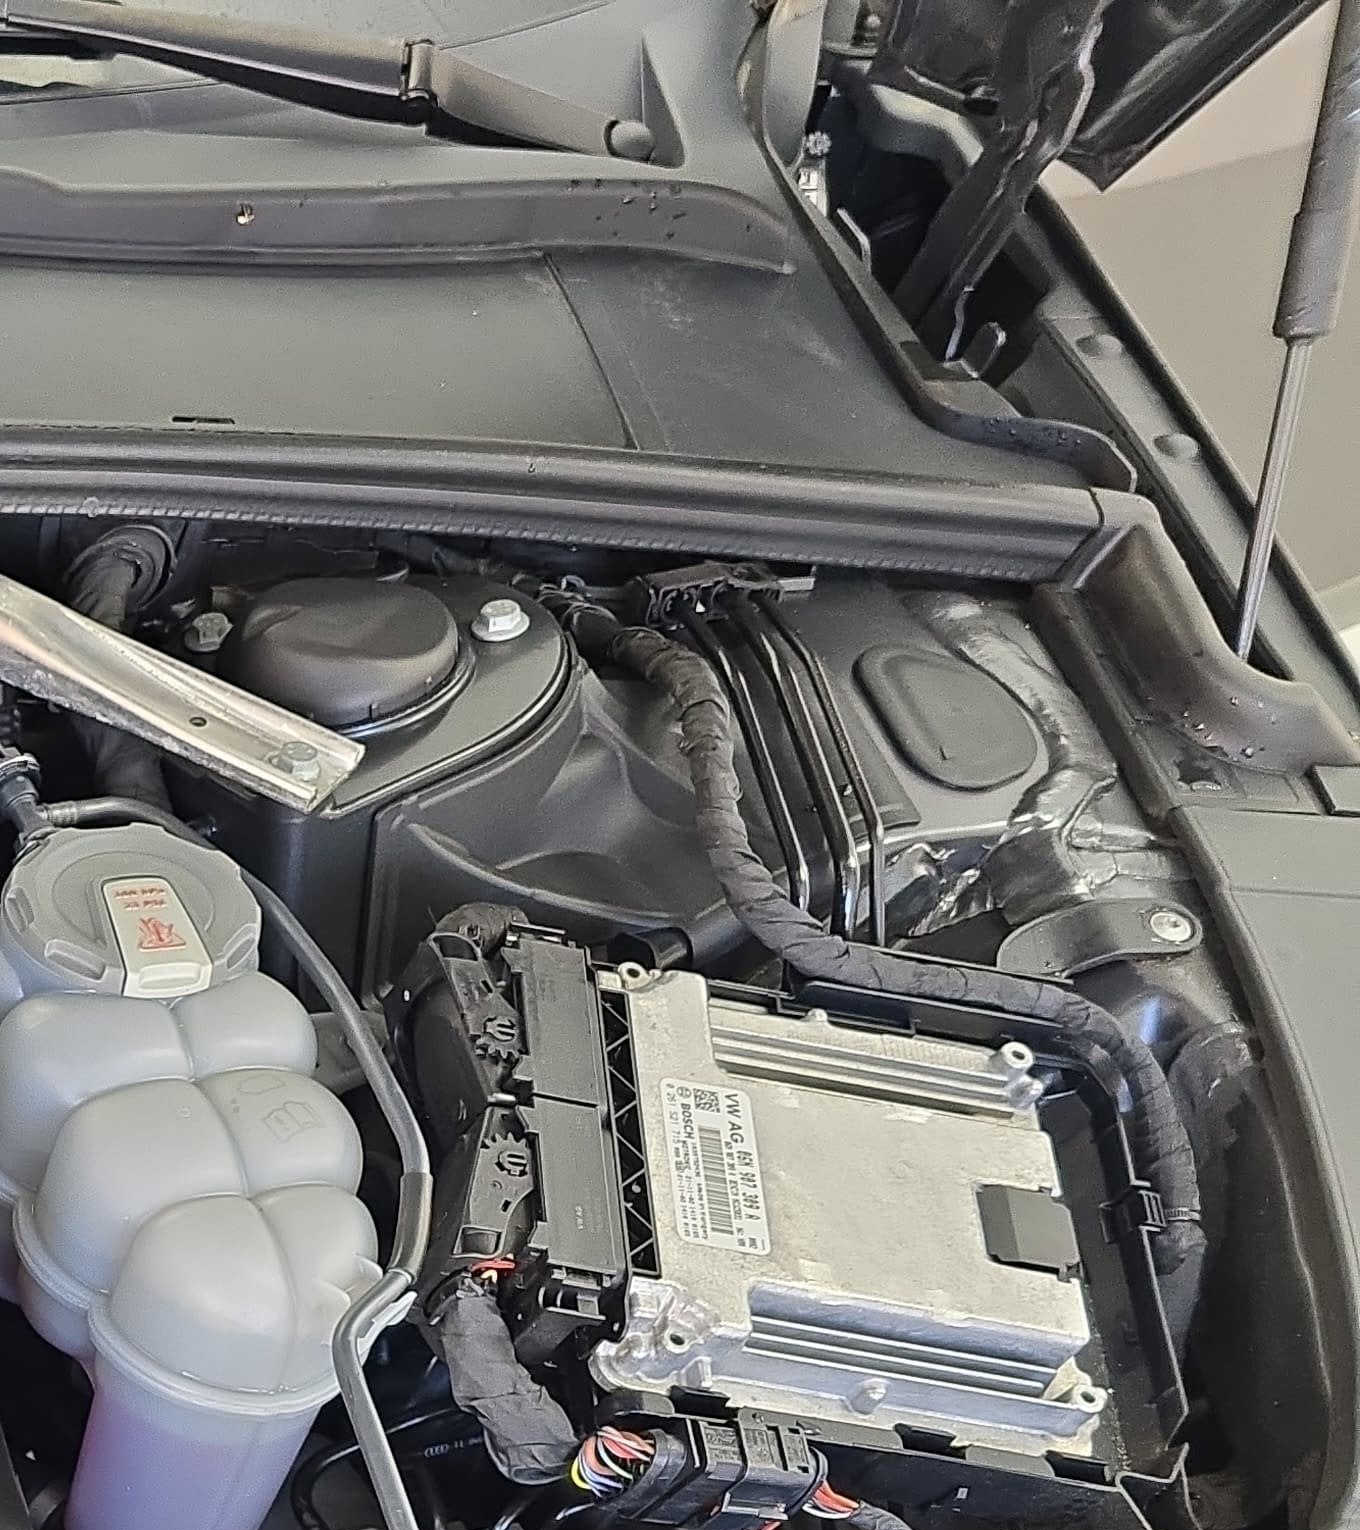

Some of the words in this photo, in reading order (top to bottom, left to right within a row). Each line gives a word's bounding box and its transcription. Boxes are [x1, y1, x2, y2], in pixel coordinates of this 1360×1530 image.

[723, 1091, 741, 1118] VW
[678, 1102, 695, 1140] BOSCH
[727, 1120, 744, 1144] AG
